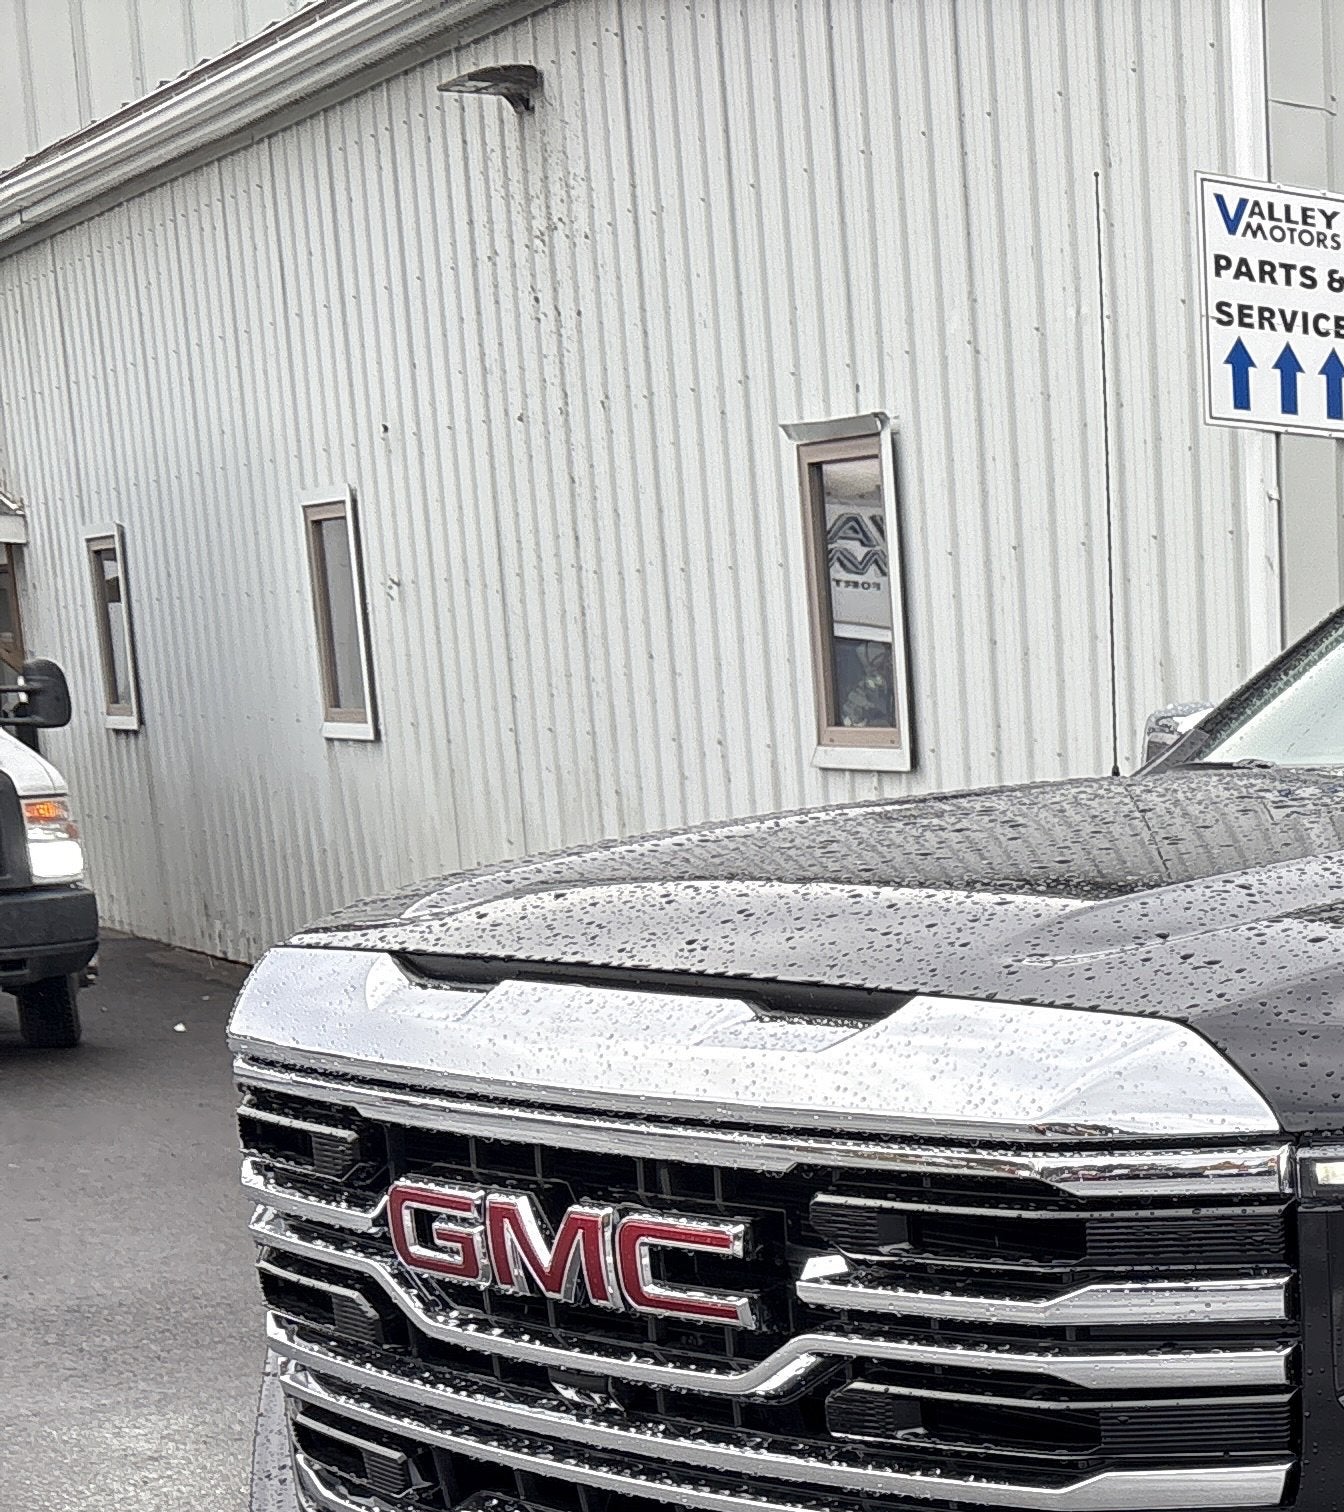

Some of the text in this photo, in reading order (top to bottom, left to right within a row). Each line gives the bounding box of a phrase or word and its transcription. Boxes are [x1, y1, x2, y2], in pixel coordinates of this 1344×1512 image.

[1213, 193, 1340, 236] VALLEY
[1241, 221, 1342, 251] MOTORS
[1213, 254, 1318, 290] PARTS
[388, 1178, 757, 1332] GMC
